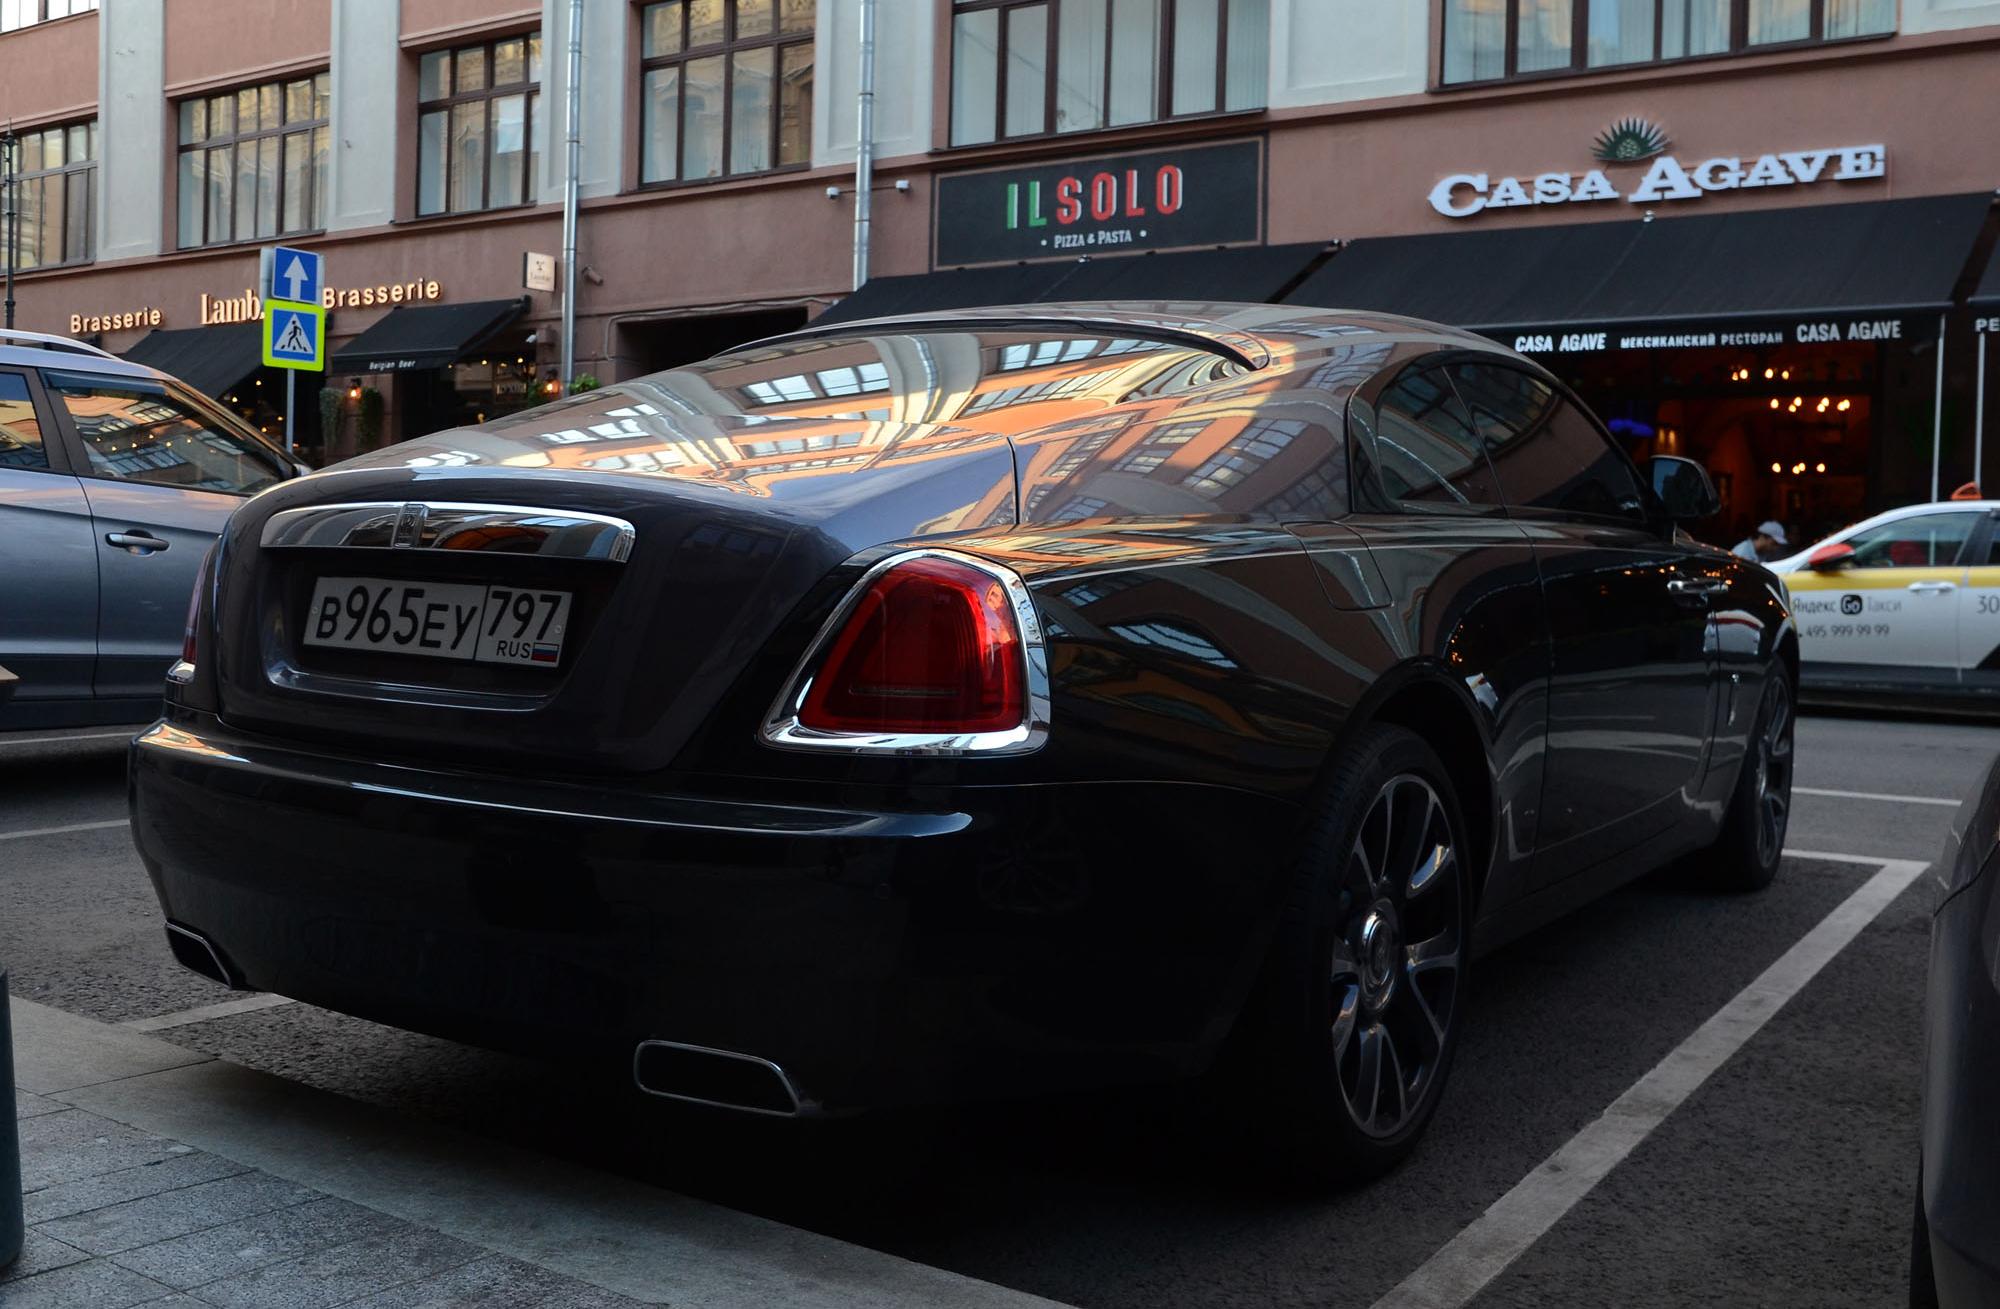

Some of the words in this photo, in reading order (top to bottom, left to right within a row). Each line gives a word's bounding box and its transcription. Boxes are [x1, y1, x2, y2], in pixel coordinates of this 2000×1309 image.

[1427, 169, 1620, 219] CASA
[1628, 144, 1888, 204] AGAVE
[1054, 234, 1085, 248] PIZZA
[1087, 233, 1095, 244] &
[1097, 229, 1132, 245] PASTA
[322, 278, 440, 309] Brasserie
[70, 307, 162, 334] Brasserie
[1796, 324, 1840, 343] CASA
[1848, 320, 1901, 340] AGAVE
[1515, 335, 1553, 352] CASA
[1559, 333, 1607, 351] AGAVE
[1620, 333, 1715, 349] МЕКСИКАНСКИЙ
[1721, 332, 1783, 346] РЕСТОРАН
[488, 590, 562, 641] 797
[496, 640, 530, 659] RUS
